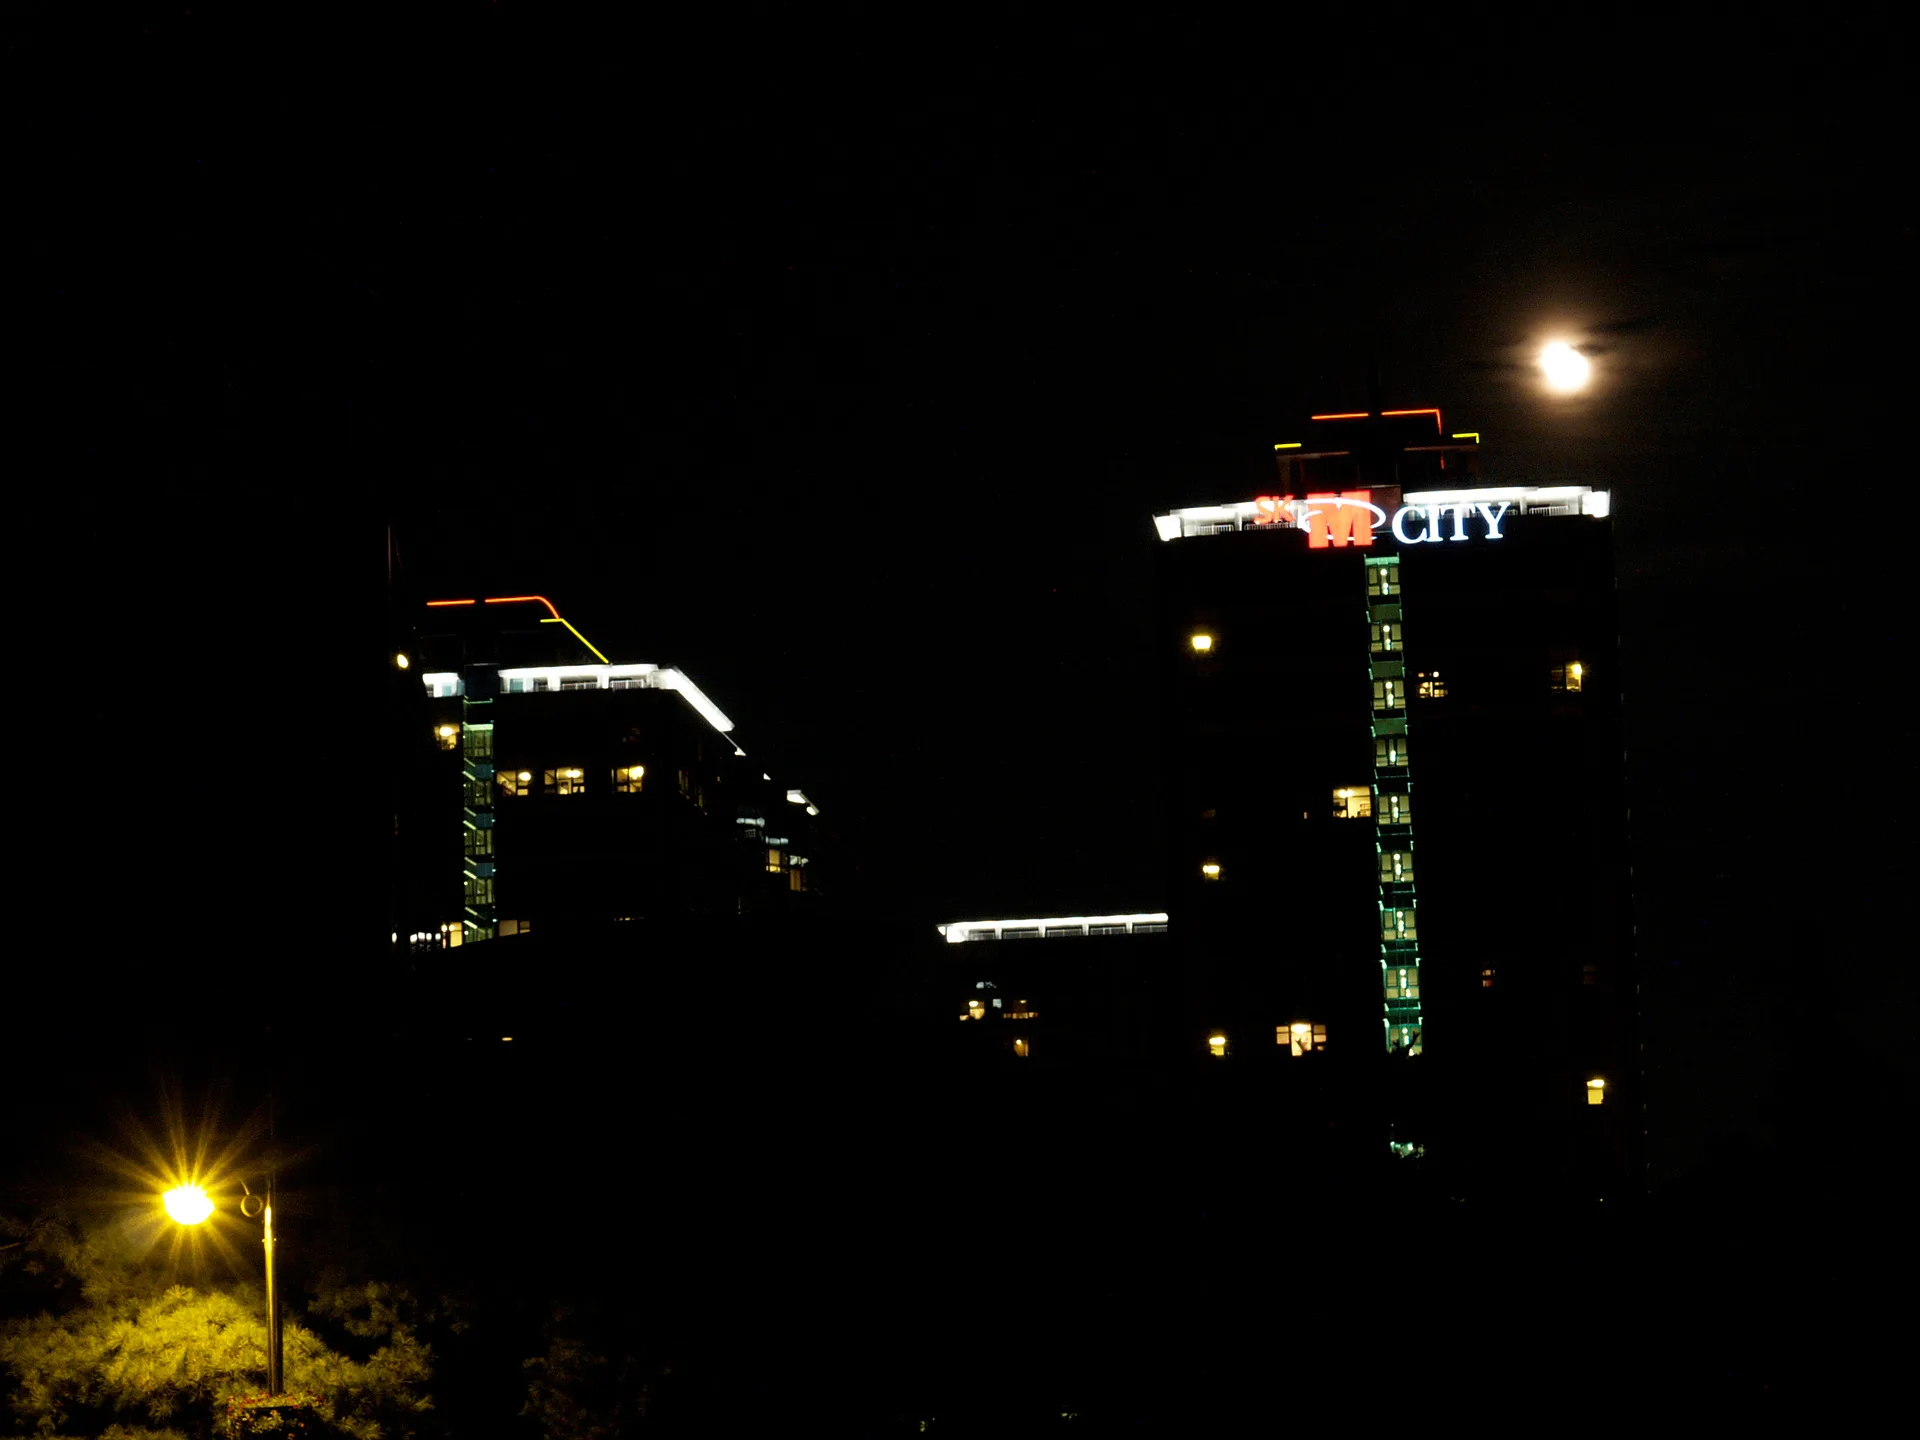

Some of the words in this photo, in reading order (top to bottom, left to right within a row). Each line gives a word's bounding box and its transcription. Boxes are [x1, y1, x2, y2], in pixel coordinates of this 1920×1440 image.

[1254, 494, 1295, 524] SK
[1307, 490, 1373, 549] M
[1392, 501, 1511, 544] CITY
